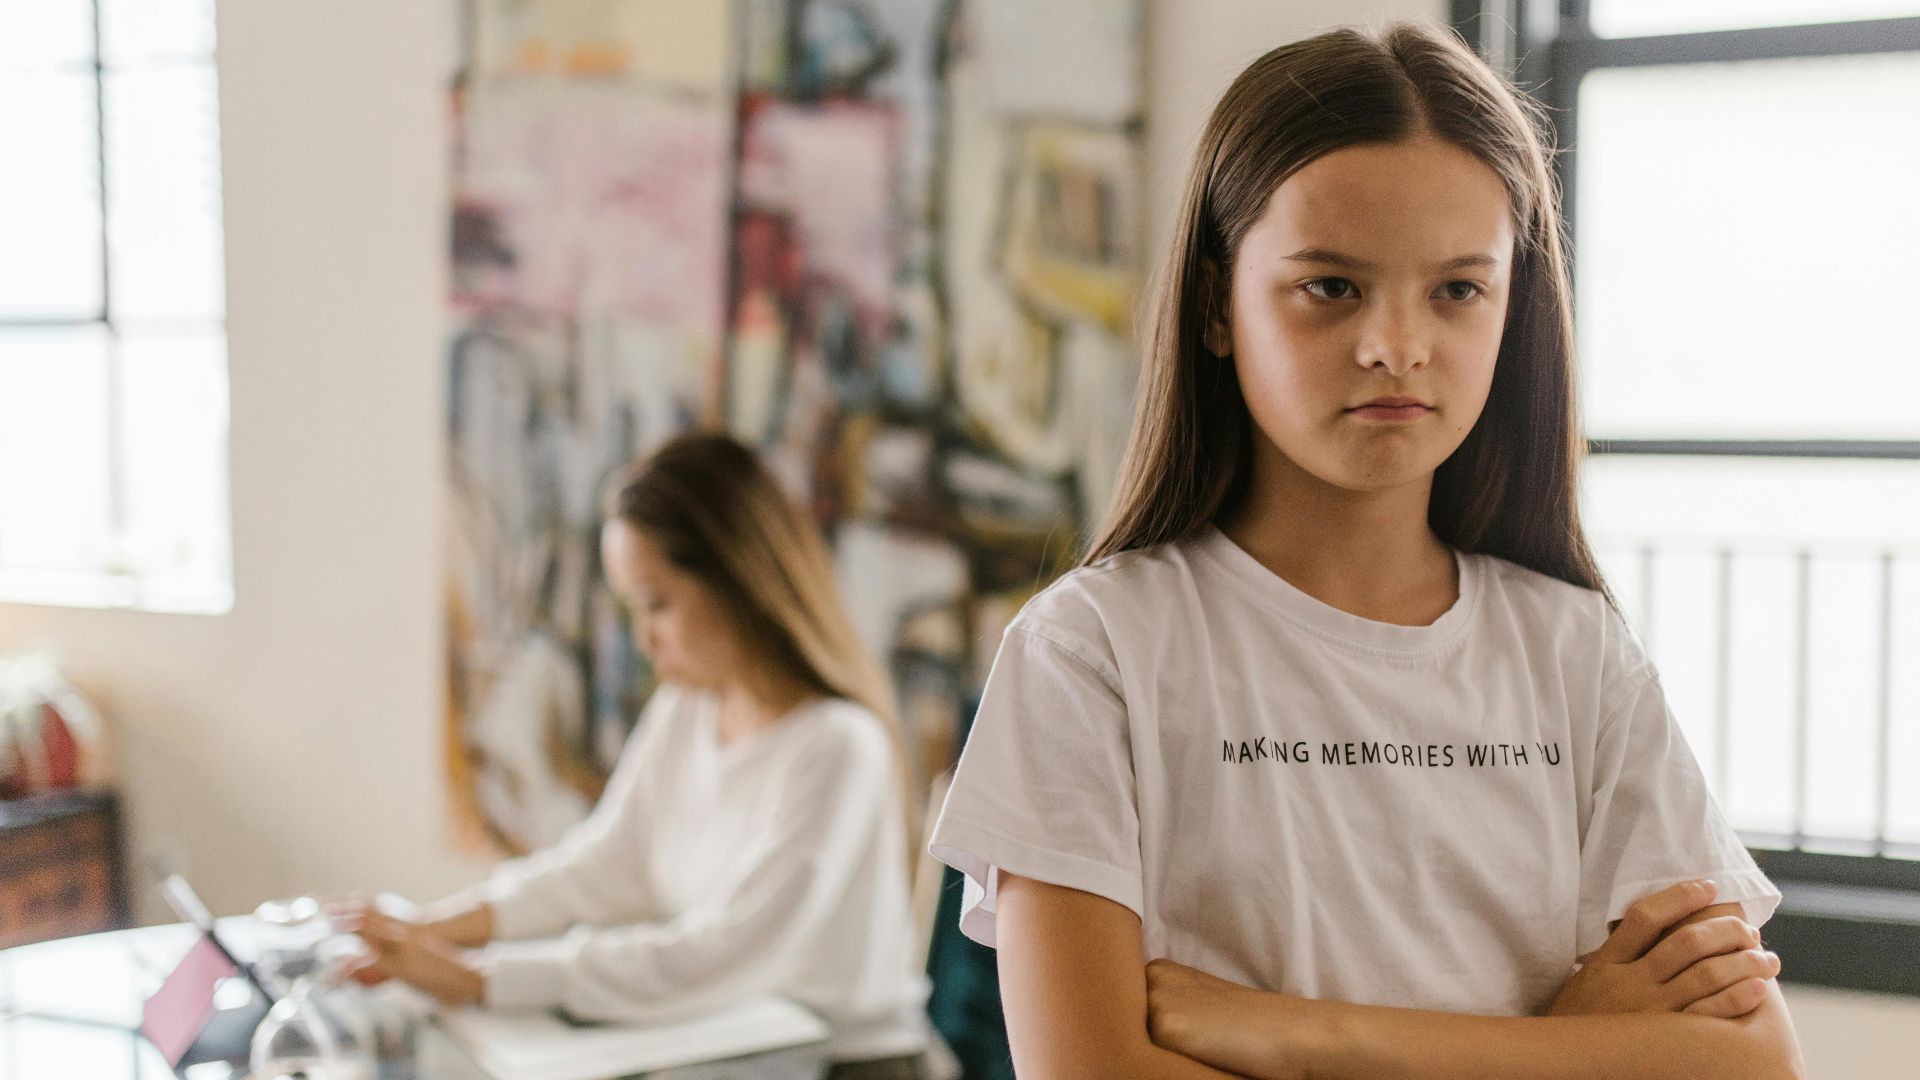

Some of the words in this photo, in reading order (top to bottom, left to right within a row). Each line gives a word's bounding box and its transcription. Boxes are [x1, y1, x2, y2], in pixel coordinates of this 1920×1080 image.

[1223, 737, 1309, 763] MAKING
[1322, 742, 1453, 767] MEMORIES
[1467, 744, 1528, 767] WITH
